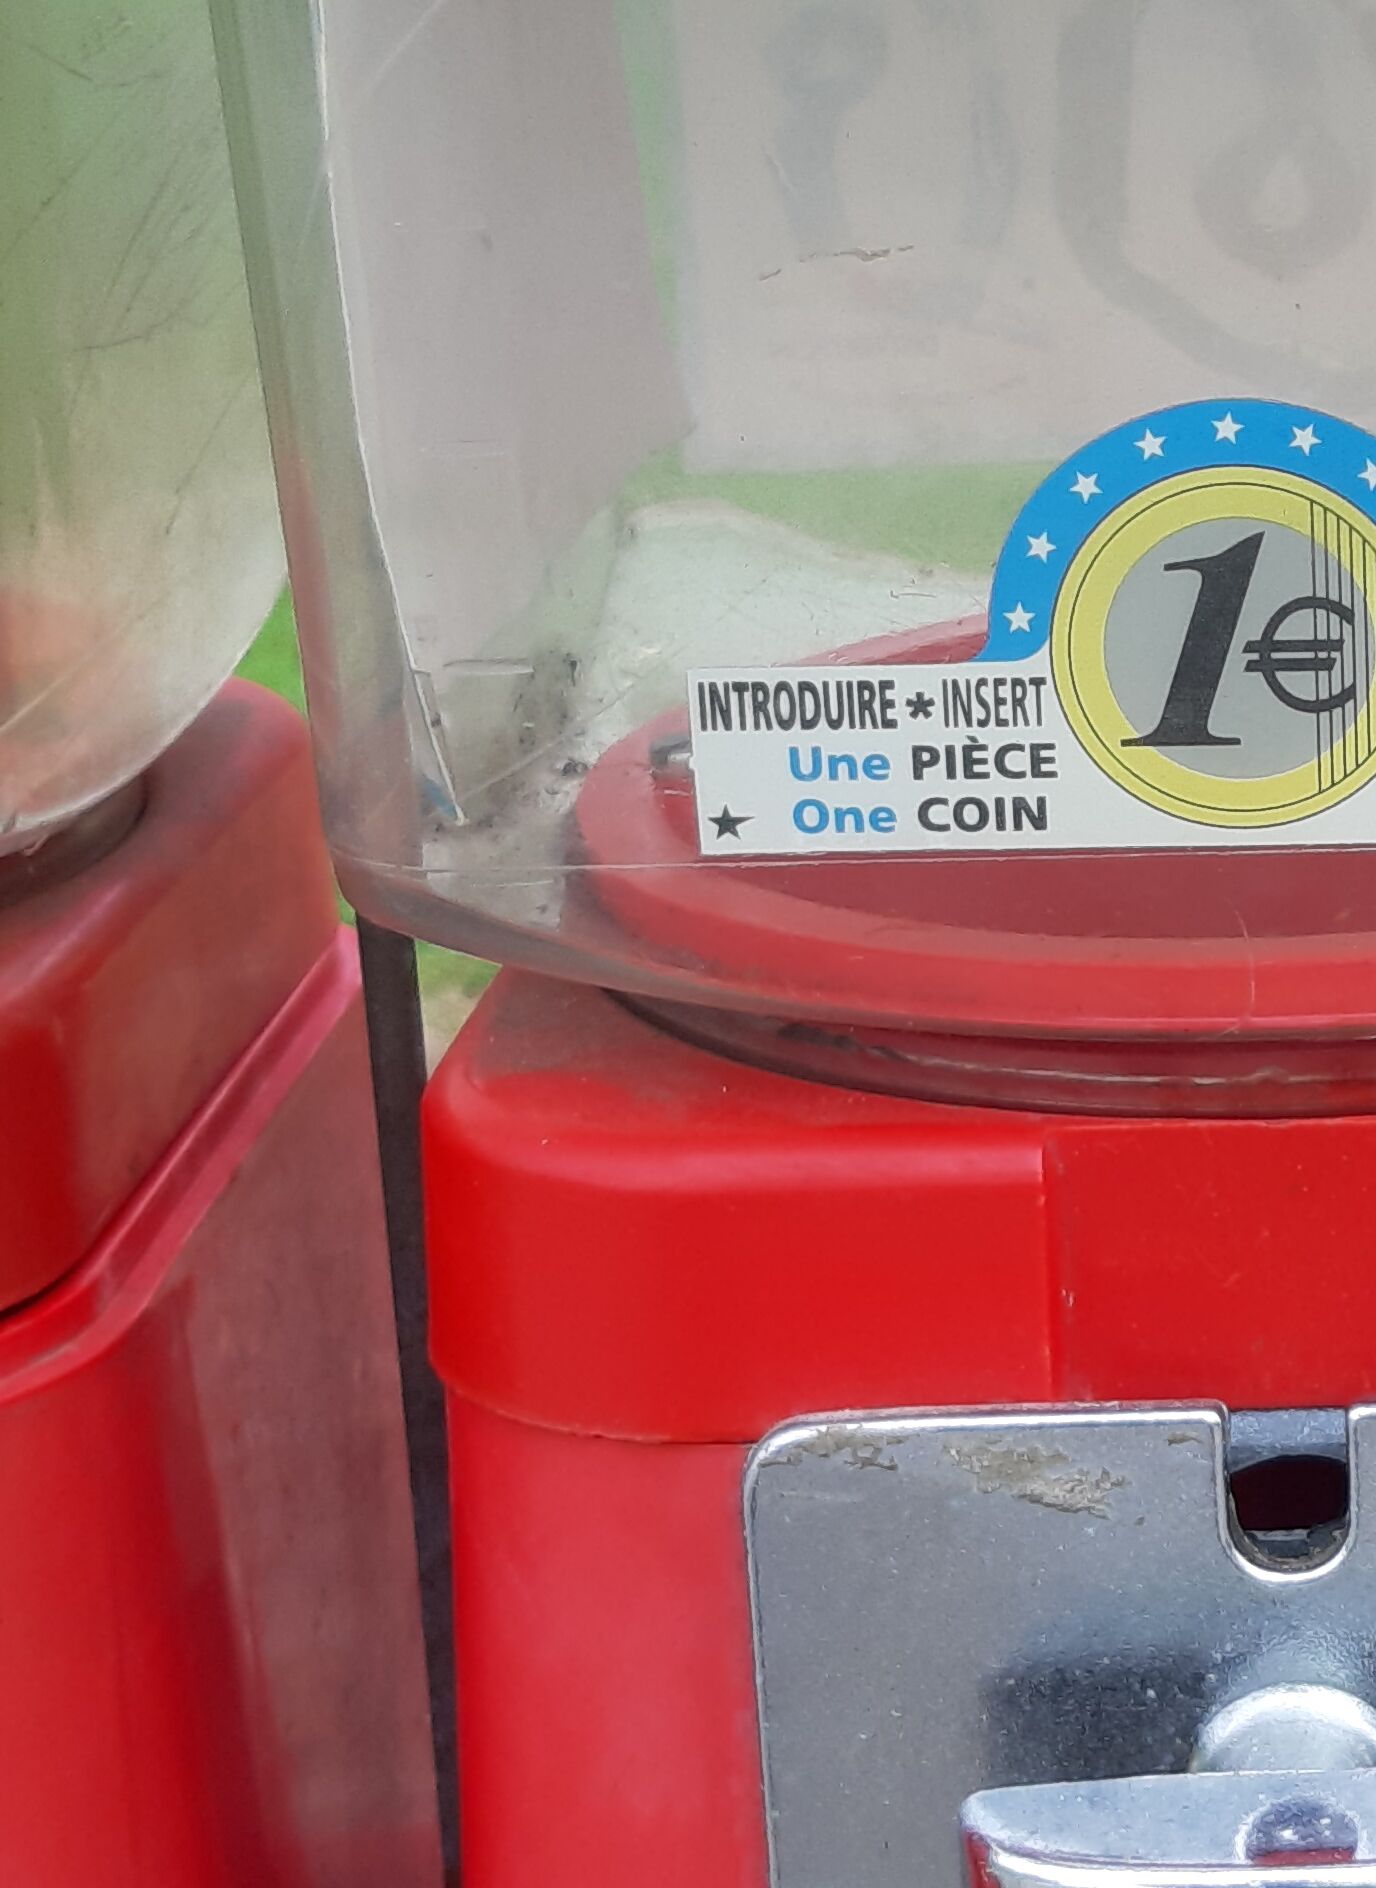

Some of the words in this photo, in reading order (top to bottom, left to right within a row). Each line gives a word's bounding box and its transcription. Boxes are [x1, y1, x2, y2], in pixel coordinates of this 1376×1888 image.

[698, 679, 898, 731] INTRODUIRE
[942, 677, 1047, 728] INSERT
[787, 745, 891, 782] Une
[911, 735, 1059, 781] PIÈCE
[792, 798, 897, 834] One
[917, 796, 1048, 832] COIN
